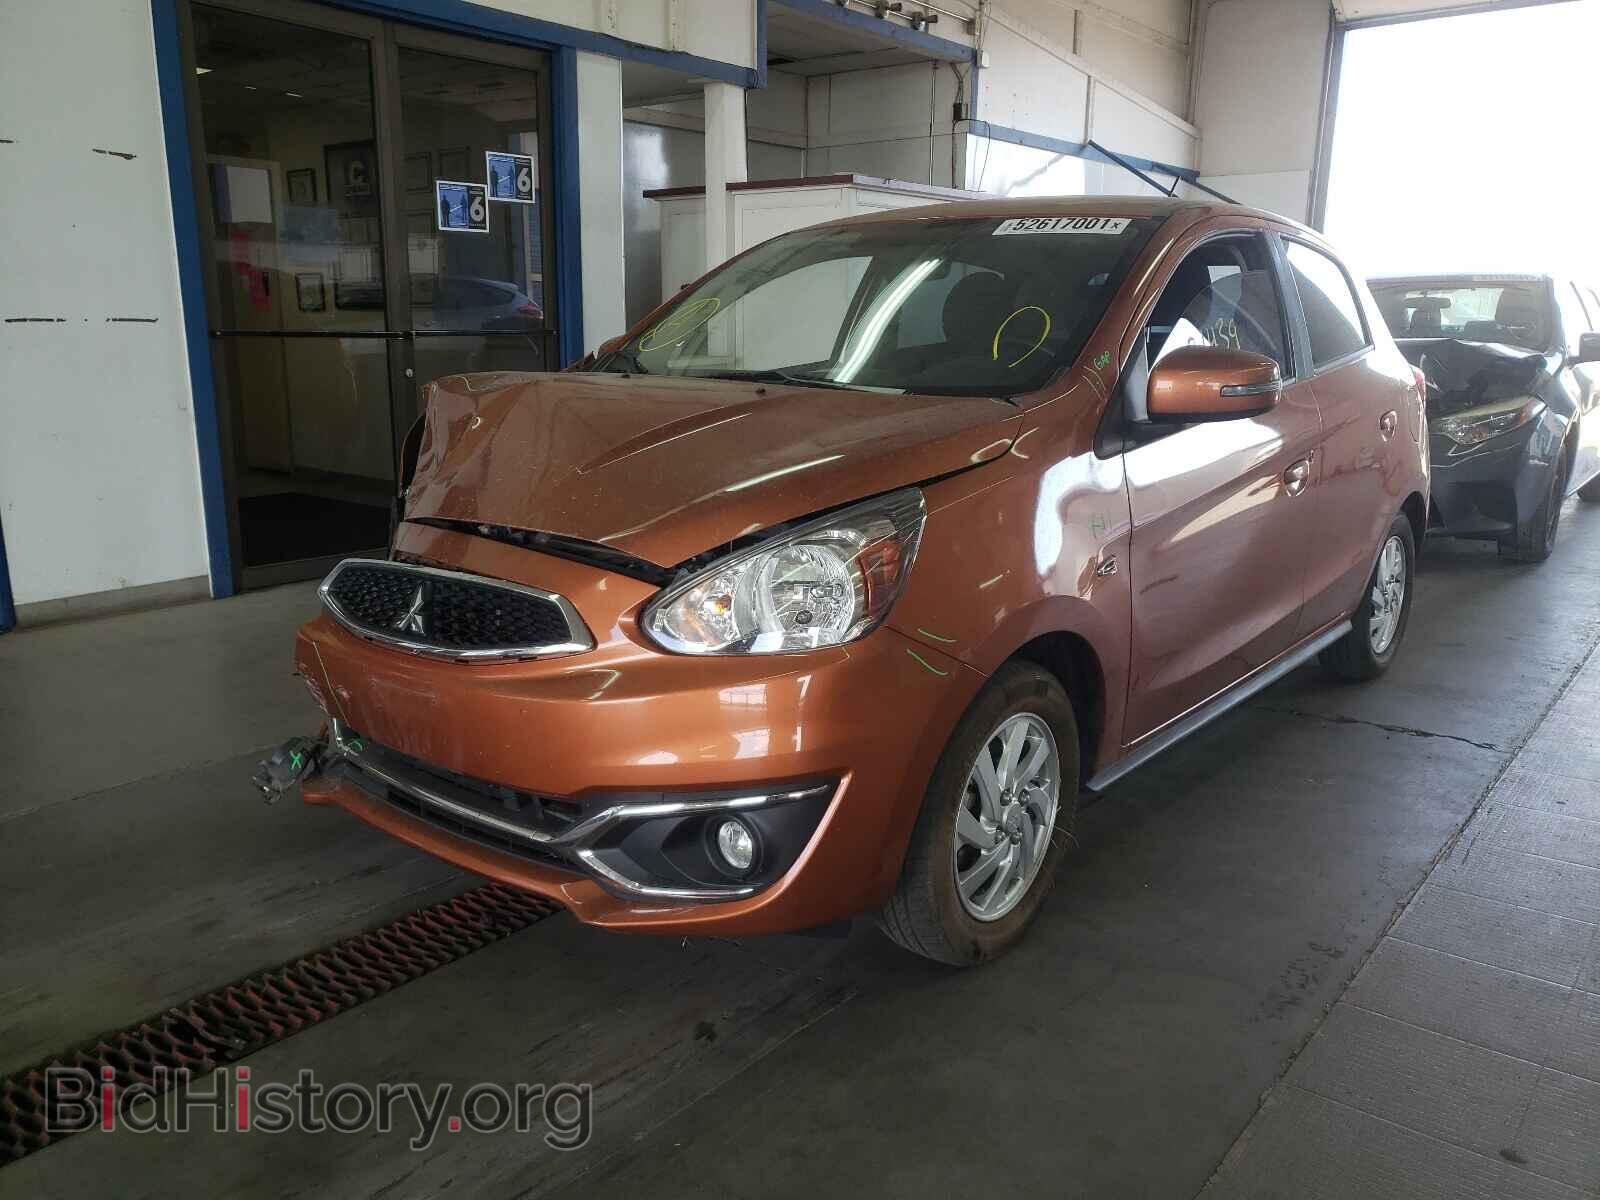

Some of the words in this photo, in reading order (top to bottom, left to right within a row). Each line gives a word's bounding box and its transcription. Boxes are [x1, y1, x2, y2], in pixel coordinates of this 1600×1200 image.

[517, 168, 531, 192] 6
[470, 196, 486, 222] 6
[1012, 217, 1111, 231] 52617001
